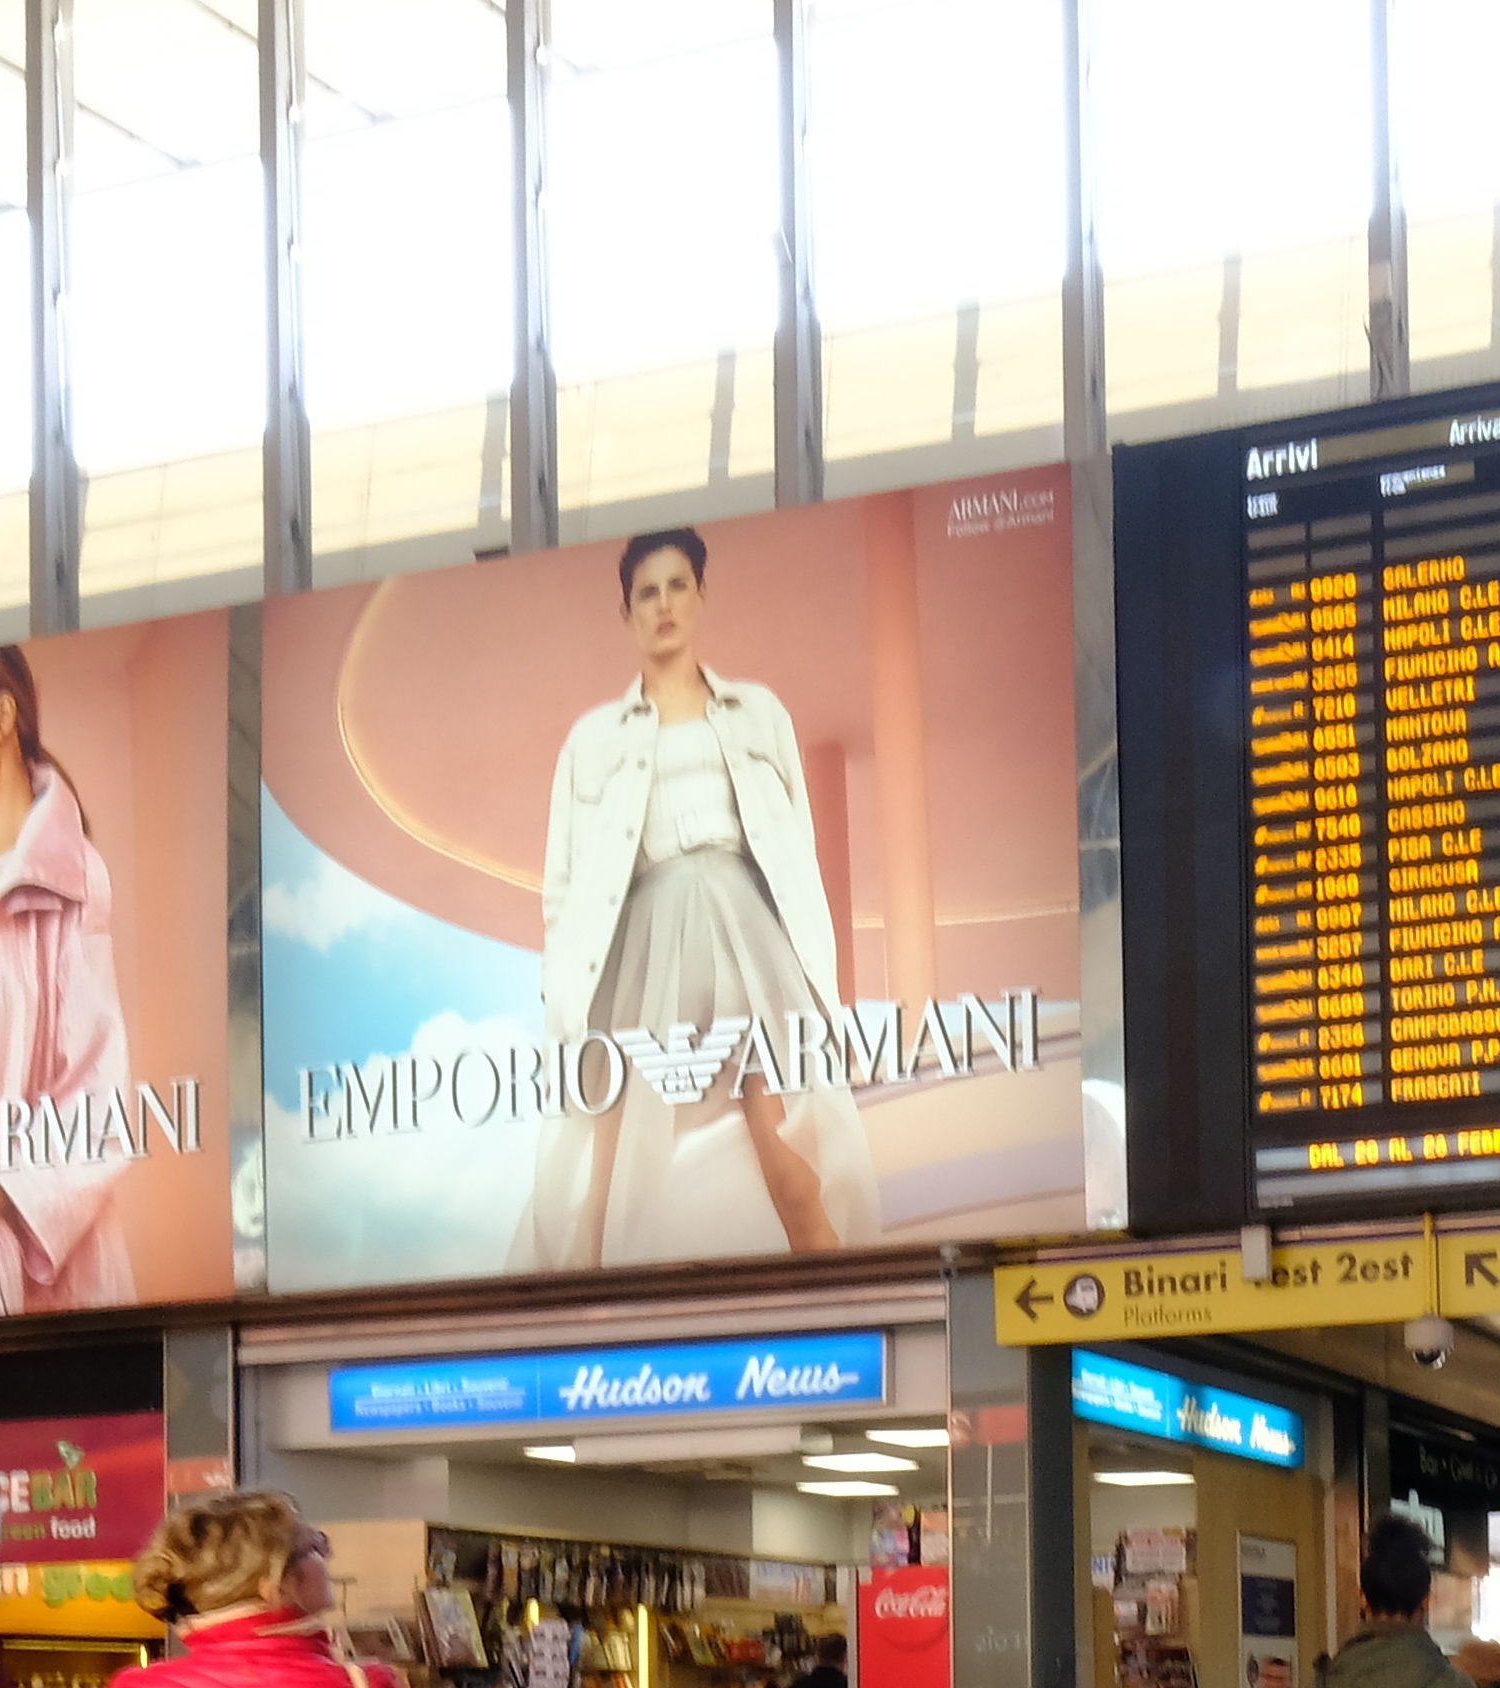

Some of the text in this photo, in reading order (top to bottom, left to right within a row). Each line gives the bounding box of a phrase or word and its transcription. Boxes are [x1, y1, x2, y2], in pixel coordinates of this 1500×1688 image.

[1247, 438, 1319, 480] Arrivi
[298, 986, 1045, 1142] EMPORIO ARMANI
[1122, 1250, 1414, 1298] Binari est 2est
[1122, 1305, 1212, 1329] Platforms
[558, 1364, 712, 1413] Hudson
[736, 1352, 860, 1404] News
[1177, 1395, 1298, 1458] Hudson News
[50, 1514, 97, 1540] food
